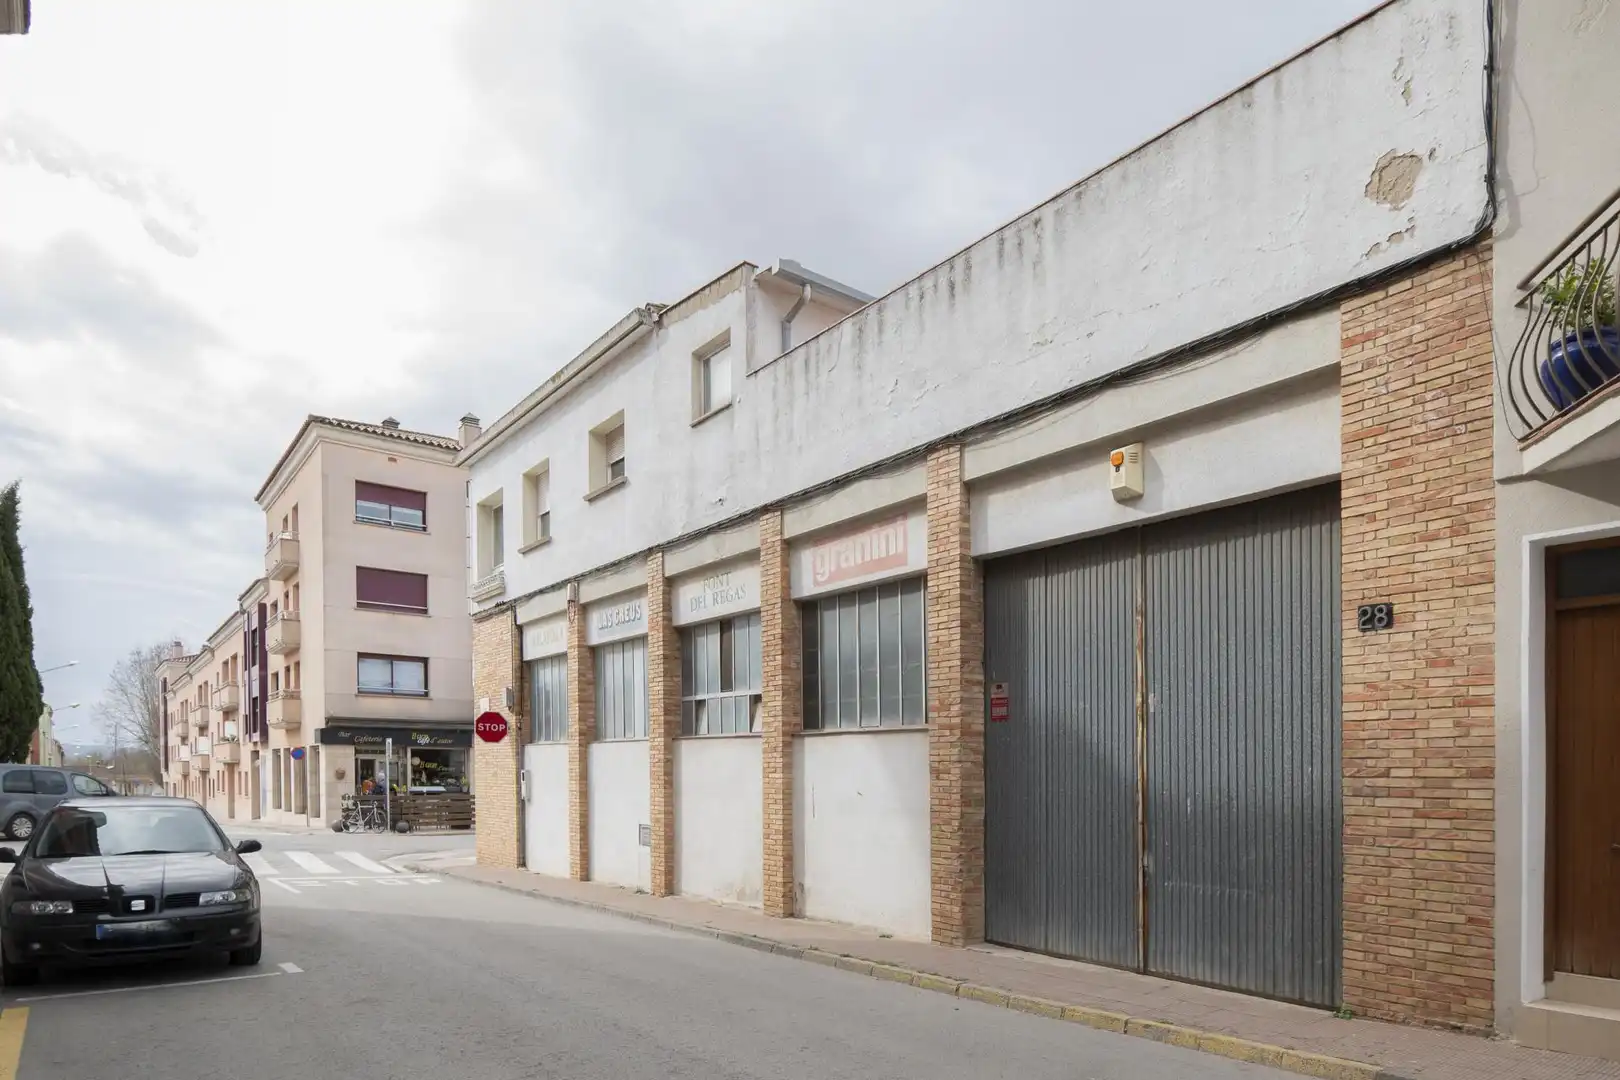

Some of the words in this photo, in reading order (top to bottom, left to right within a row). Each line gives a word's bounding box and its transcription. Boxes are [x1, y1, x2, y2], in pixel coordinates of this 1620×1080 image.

[815, 515, 905, 581] granini
[1359, 604, 1388, 629] 28
[478, 722, 506, 732] STOP
